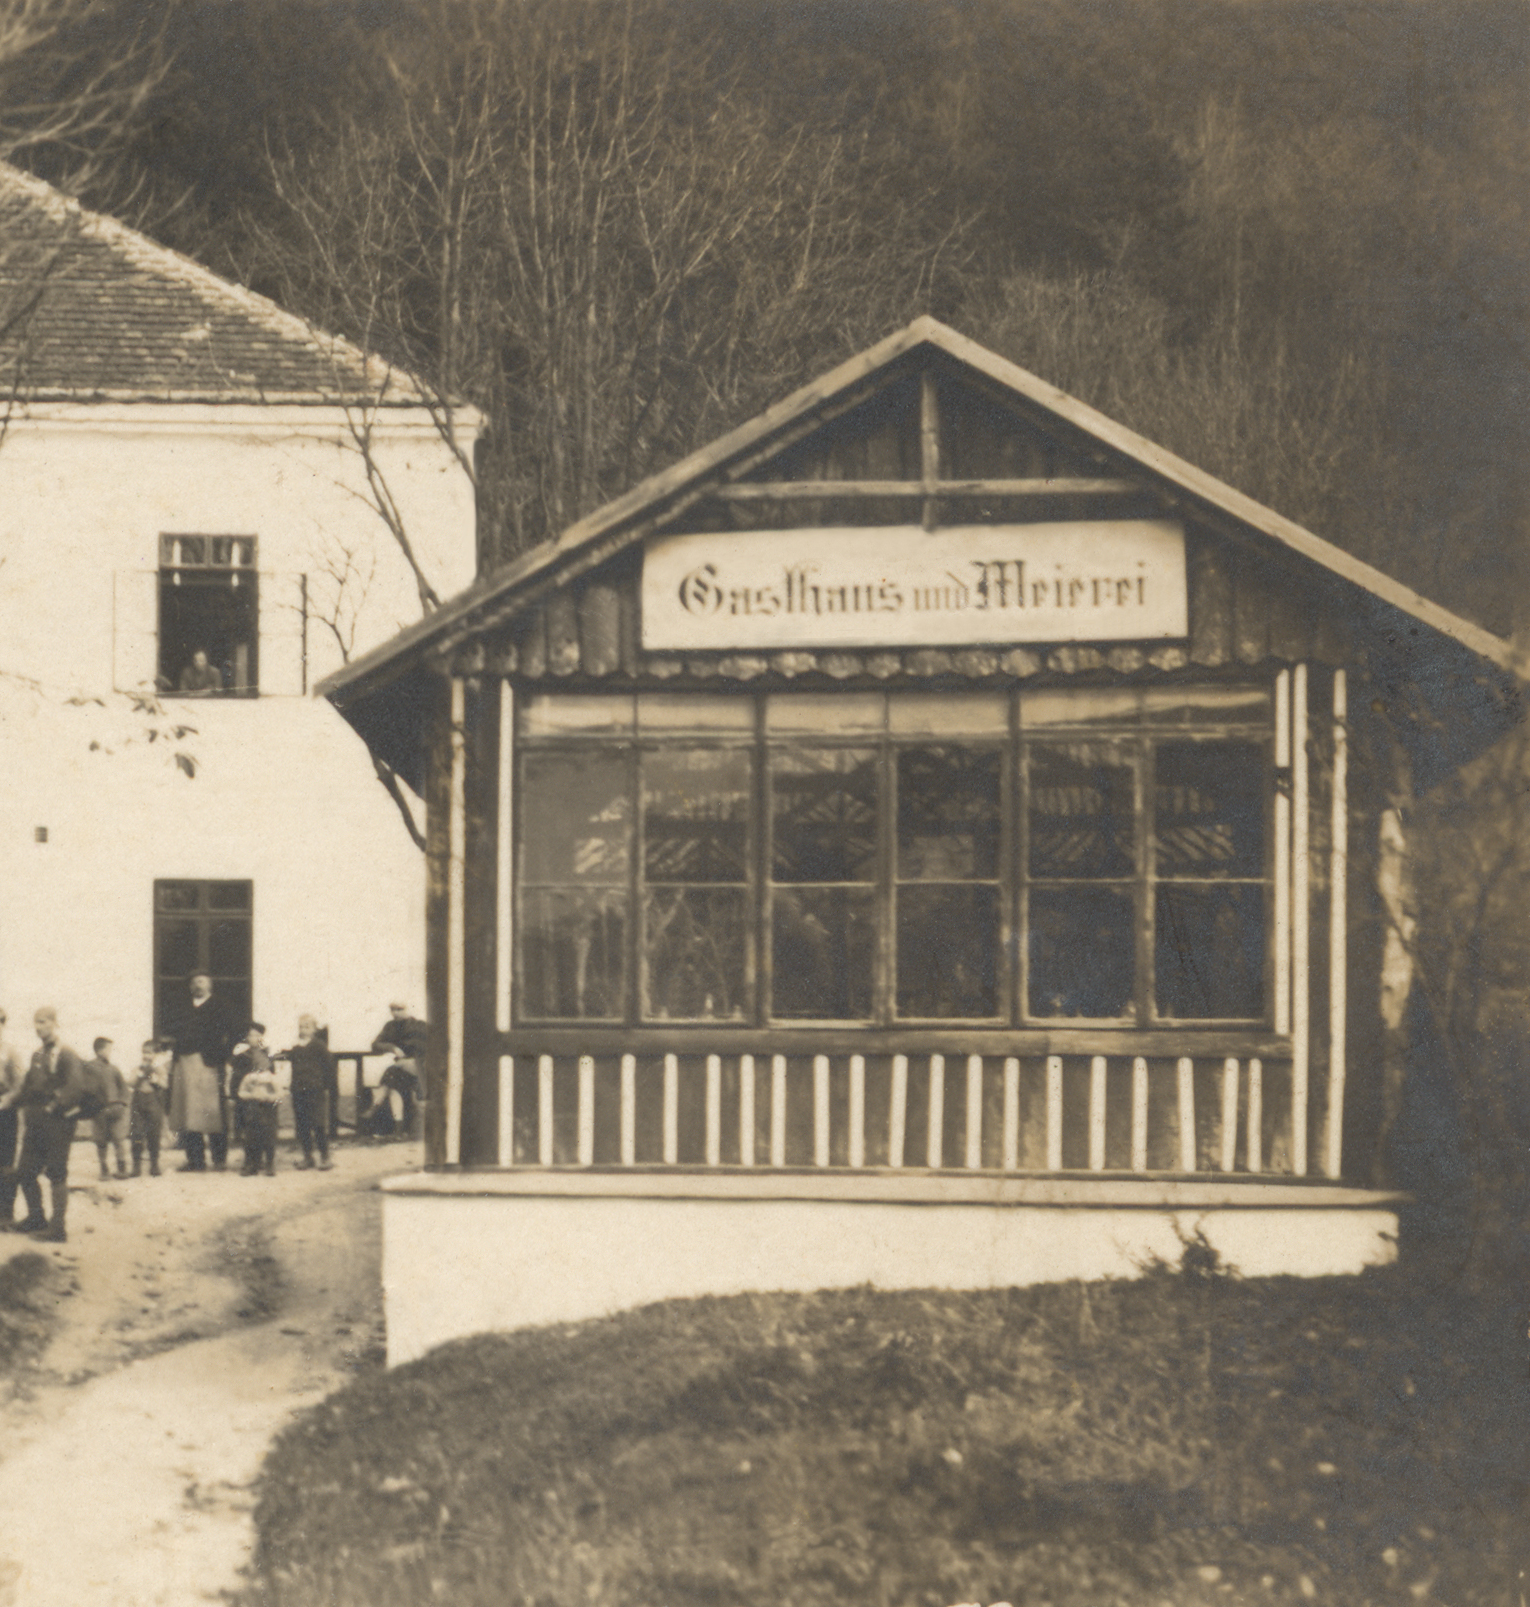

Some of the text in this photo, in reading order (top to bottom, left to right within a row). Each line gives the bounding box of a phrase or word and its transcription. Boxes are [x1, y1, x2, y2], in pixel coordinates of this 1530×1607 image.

[678, 560, 1146, 616] Gasthaus und Meierei
